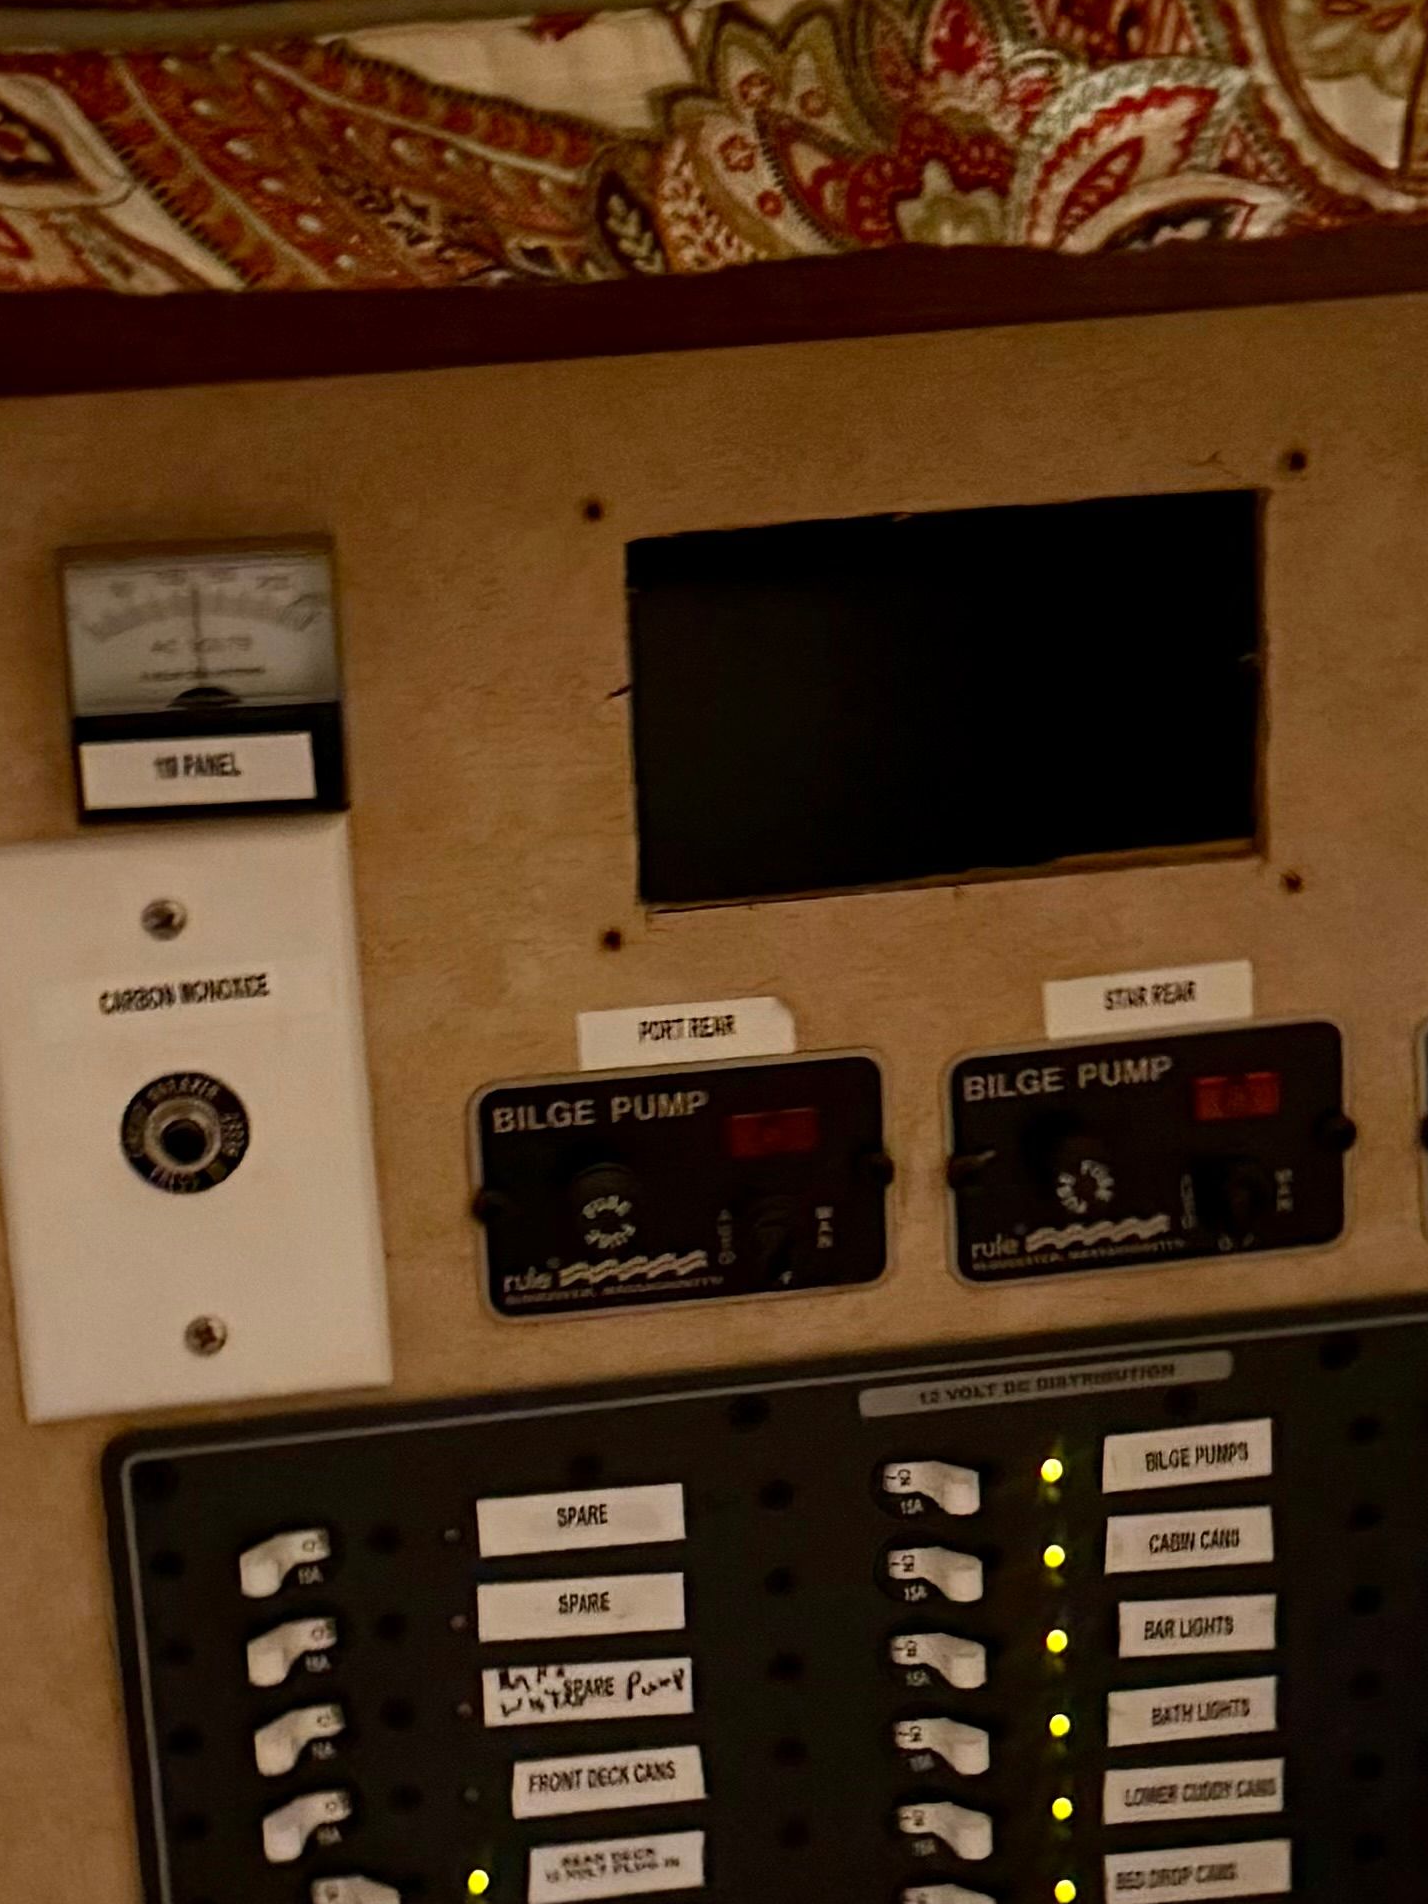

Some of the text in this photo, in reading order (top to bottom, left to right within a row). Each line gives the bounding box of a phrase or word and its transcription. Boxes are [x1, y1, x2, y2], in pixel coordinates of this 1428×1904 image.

[182, 751, 242, 778] PANEL
[99, 972, 271, 1015] CARBON MONOXIDE
[1103, 979, 1197, 1011] STAR REAR
[638, 1014, 737, 1044] PORT REAR
[963, 1055, 1172, 1102] BILGE PUMP
[492, 1090, 710, 1134] BILGE PUMP
[972, 1234, 1019, 1260] rule
[503, 1265, 553, 1293] rule
[919, 1389, 940, 1405] 12
[945, 1382, 1000, 1402] VOLT
[1036, 1363, 1176, 1391] DISTRIBUTION
[1145, 1442, 1249, 1473] BILGE PUMPS
[557, 1503, 610, 1528] SPARE
[1148, 1528, 1240, 1555] CABIN CANS
[558, 1591, 611, 1616] SPARE
[1144, 1613, 1234, 1641] BAR LIGHTS
[562, 1676, 615, 1698] SPARE
[1151, 1698, 1251, 1728] BATH LIGHTS
[528, 1761, 677, 1795] FRONT DECK CANS
[1115, 1870, 1146, 1891] BED
